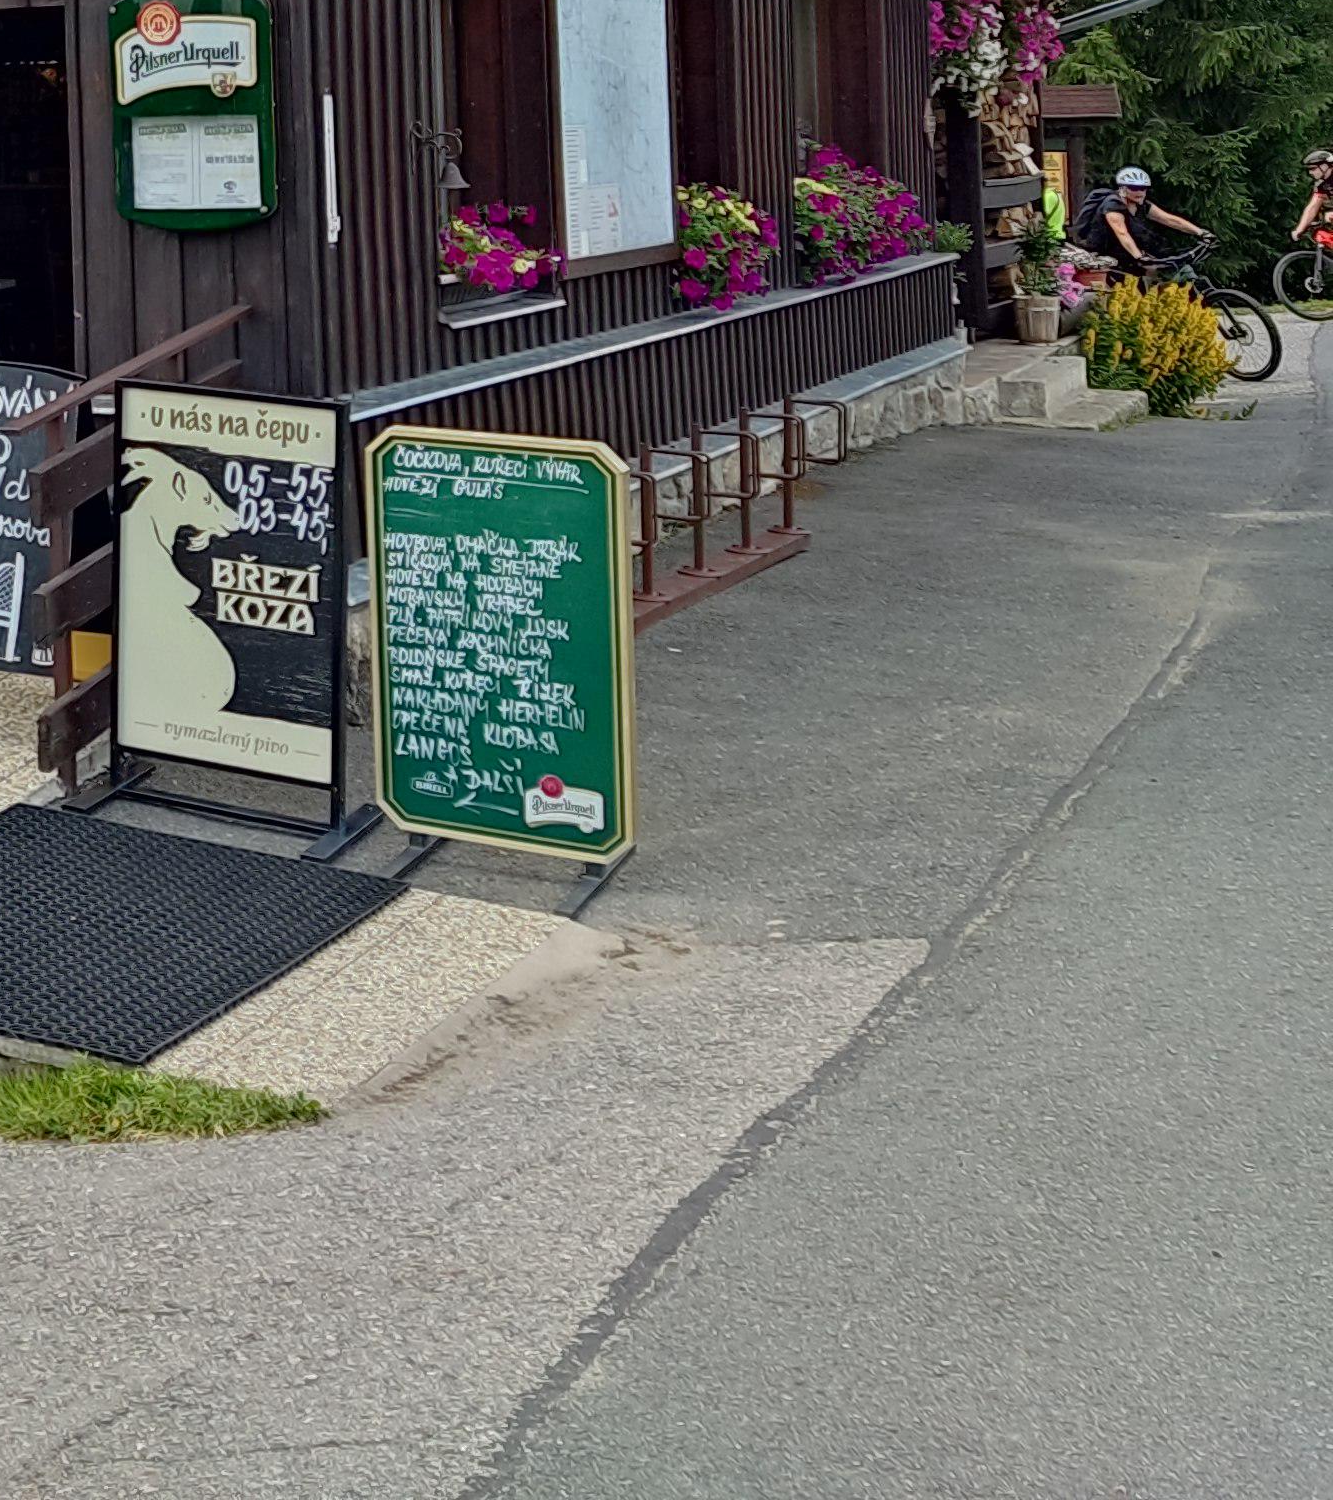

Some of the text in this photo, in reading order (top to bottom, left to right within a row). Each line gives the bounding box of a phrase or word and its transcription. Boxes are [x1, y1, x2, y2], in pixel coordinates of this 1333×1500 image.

[130, 41, 240, 83] Pilsner Urquell
[170, 403, 213, 433] nás
[218, 414, 250, 437] na
[256, 409, 310, 449] čepu
[210, 553, 323, 603] BŘEZÍ
[216, 590, 316, 636] KOZA
[164, 722, 290, 756] vymazlený pivo
